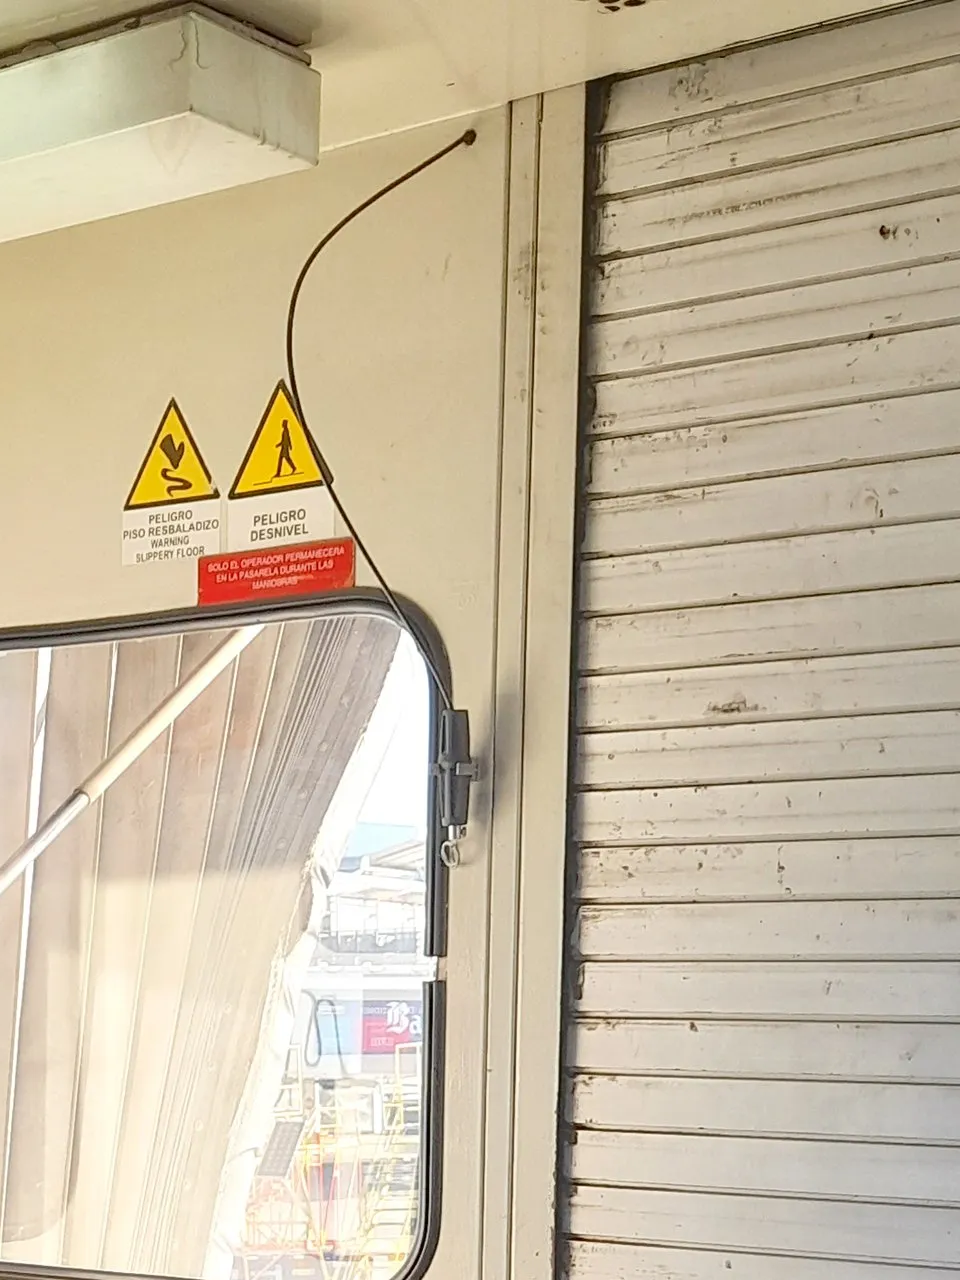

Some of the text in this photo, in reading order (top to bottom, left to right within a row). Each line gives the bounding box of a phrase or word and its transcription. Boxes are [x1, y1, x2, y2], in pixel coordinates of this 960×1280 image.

[148, 509, 193, 525] PELIGRO
[253, 508, 307, 527] PELIGRO
[122, 519, 219, 541] PISO RESBALADIZO
[250, 523, 309, 542] DESNIVEL
[150, 535, 190, 549] WARNING
[136, 545, 205, 563] SLIPPERY FLOOR
[207, 561, 229, 573] SOLO
[230, 560, 240, 570] EL
[241, 555, 284, 568] OPERADOR
[216, 559, 334, 583] EN LA PASARELA DURANTE LAS
